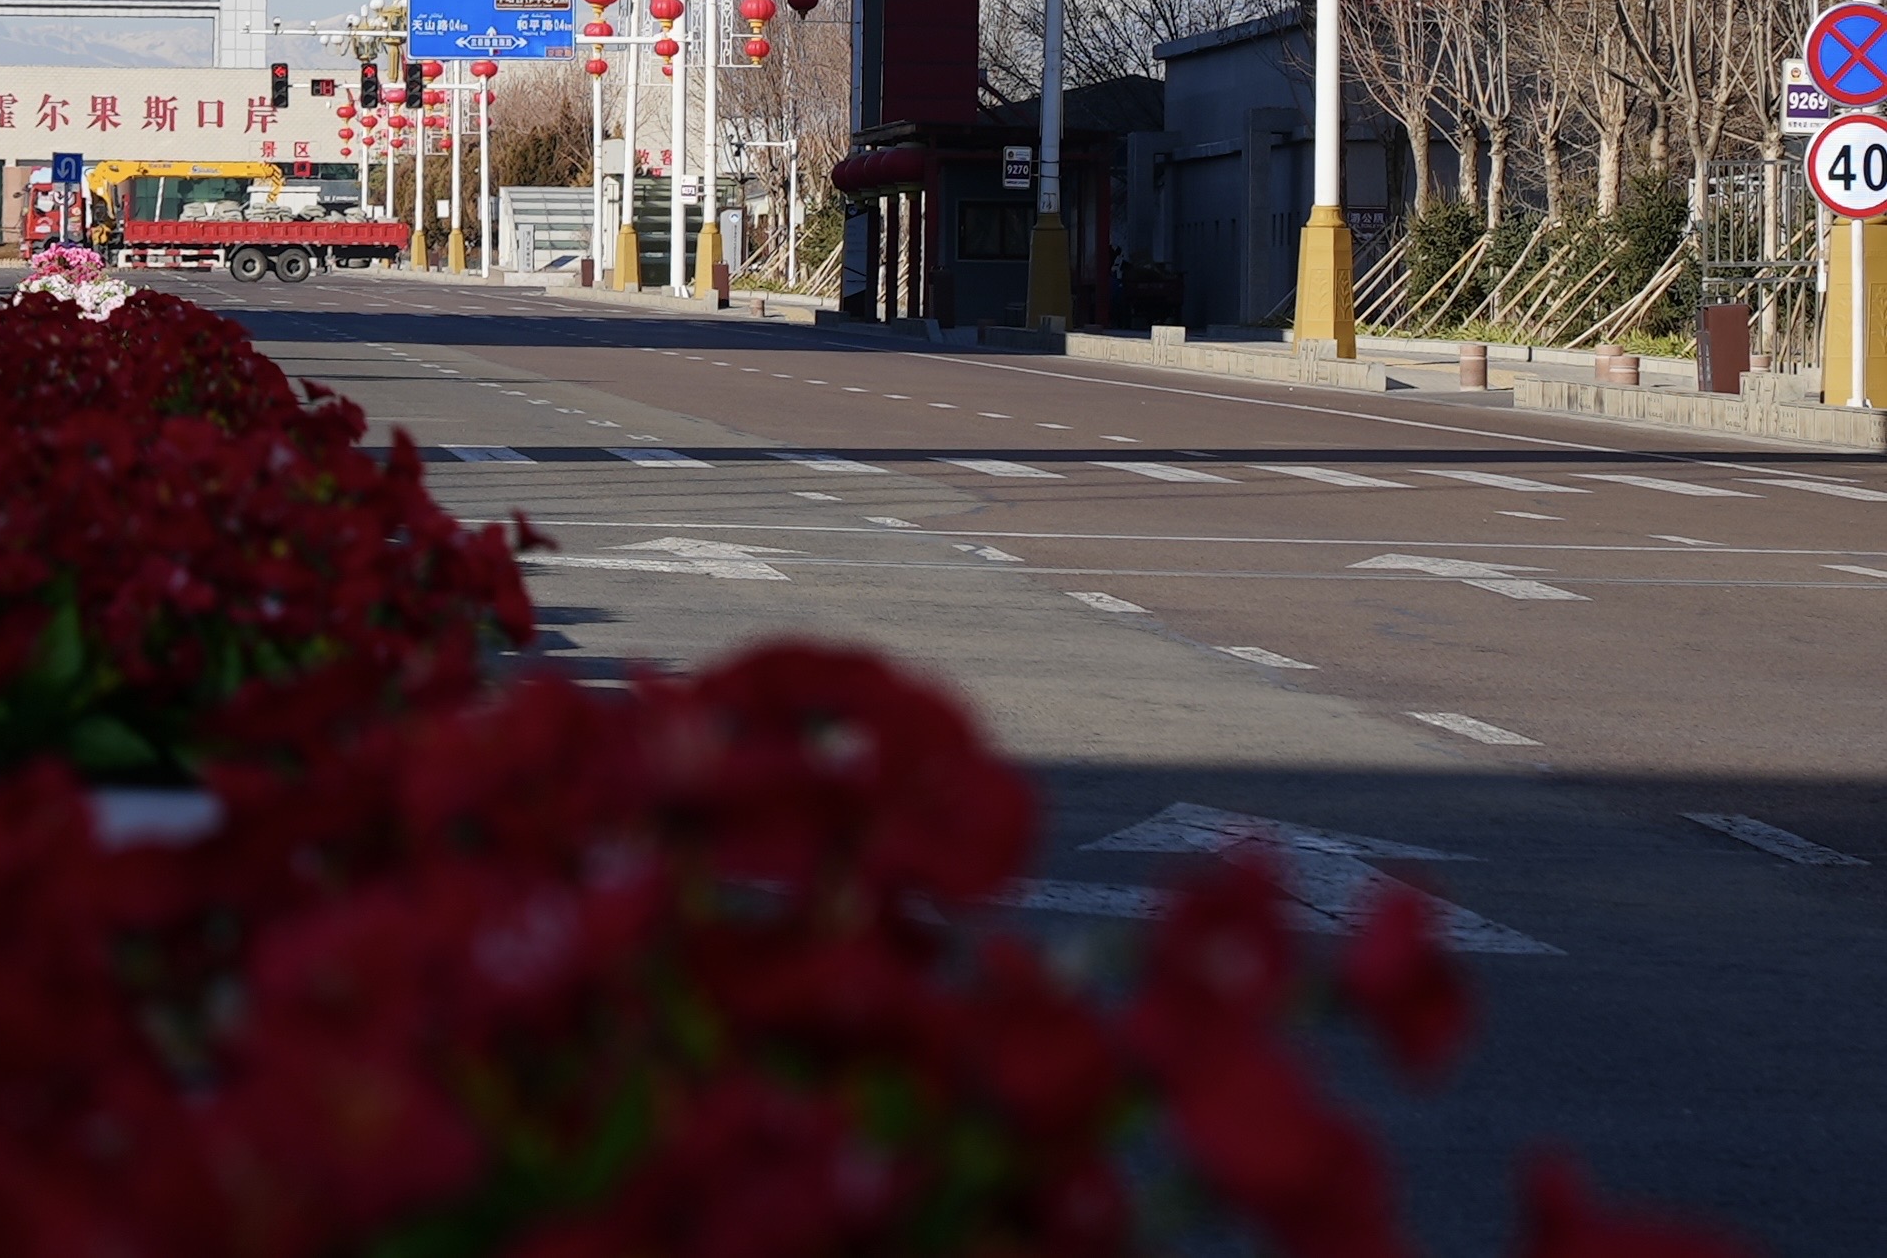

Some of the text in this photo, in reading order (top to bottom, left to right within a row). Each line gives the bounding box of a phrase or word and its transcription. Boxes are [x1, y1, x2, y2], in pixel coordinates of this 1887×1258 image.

[1788, 91, 1829, 110] 9269
[260, 141, 311, 158] 景区
[1007, 164, 1029, 175] 9270
[1827, 143, 1887, 192] 40
